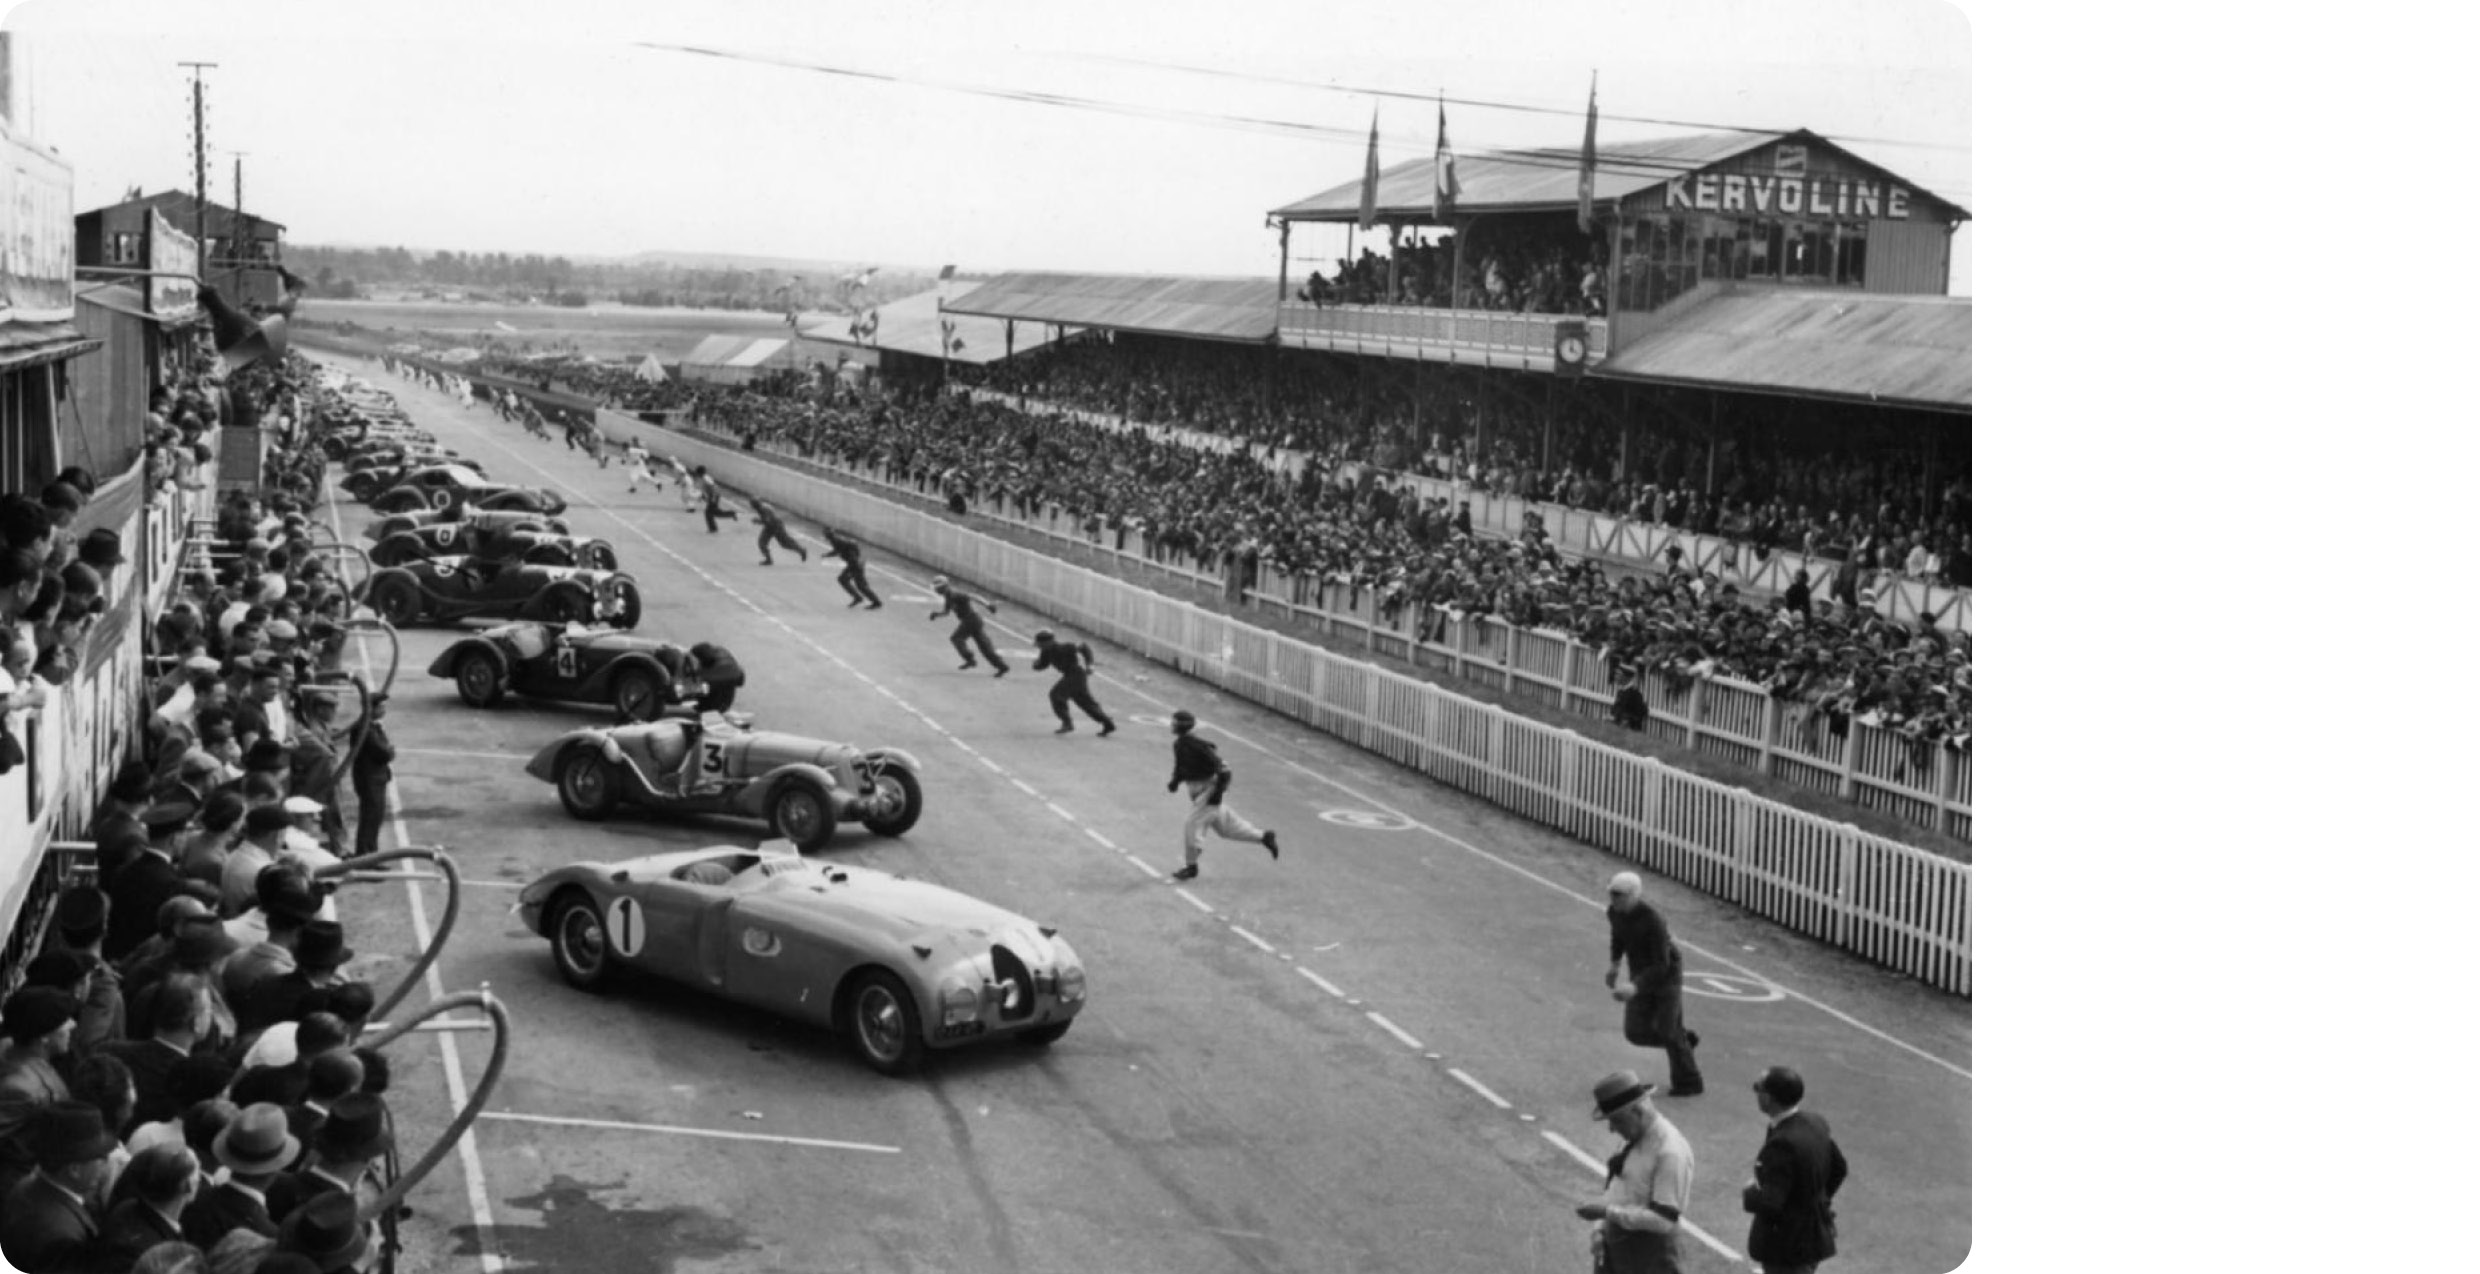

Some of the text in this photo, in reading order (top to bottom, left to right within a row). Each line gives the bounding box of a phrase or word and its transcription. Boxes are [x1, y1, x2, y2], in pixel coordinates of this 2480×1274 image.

[1665, 173, 1911, 218] KERVOLINE
[560, 652, 573, 676] 4
[618, 898, 631, 952] 1
